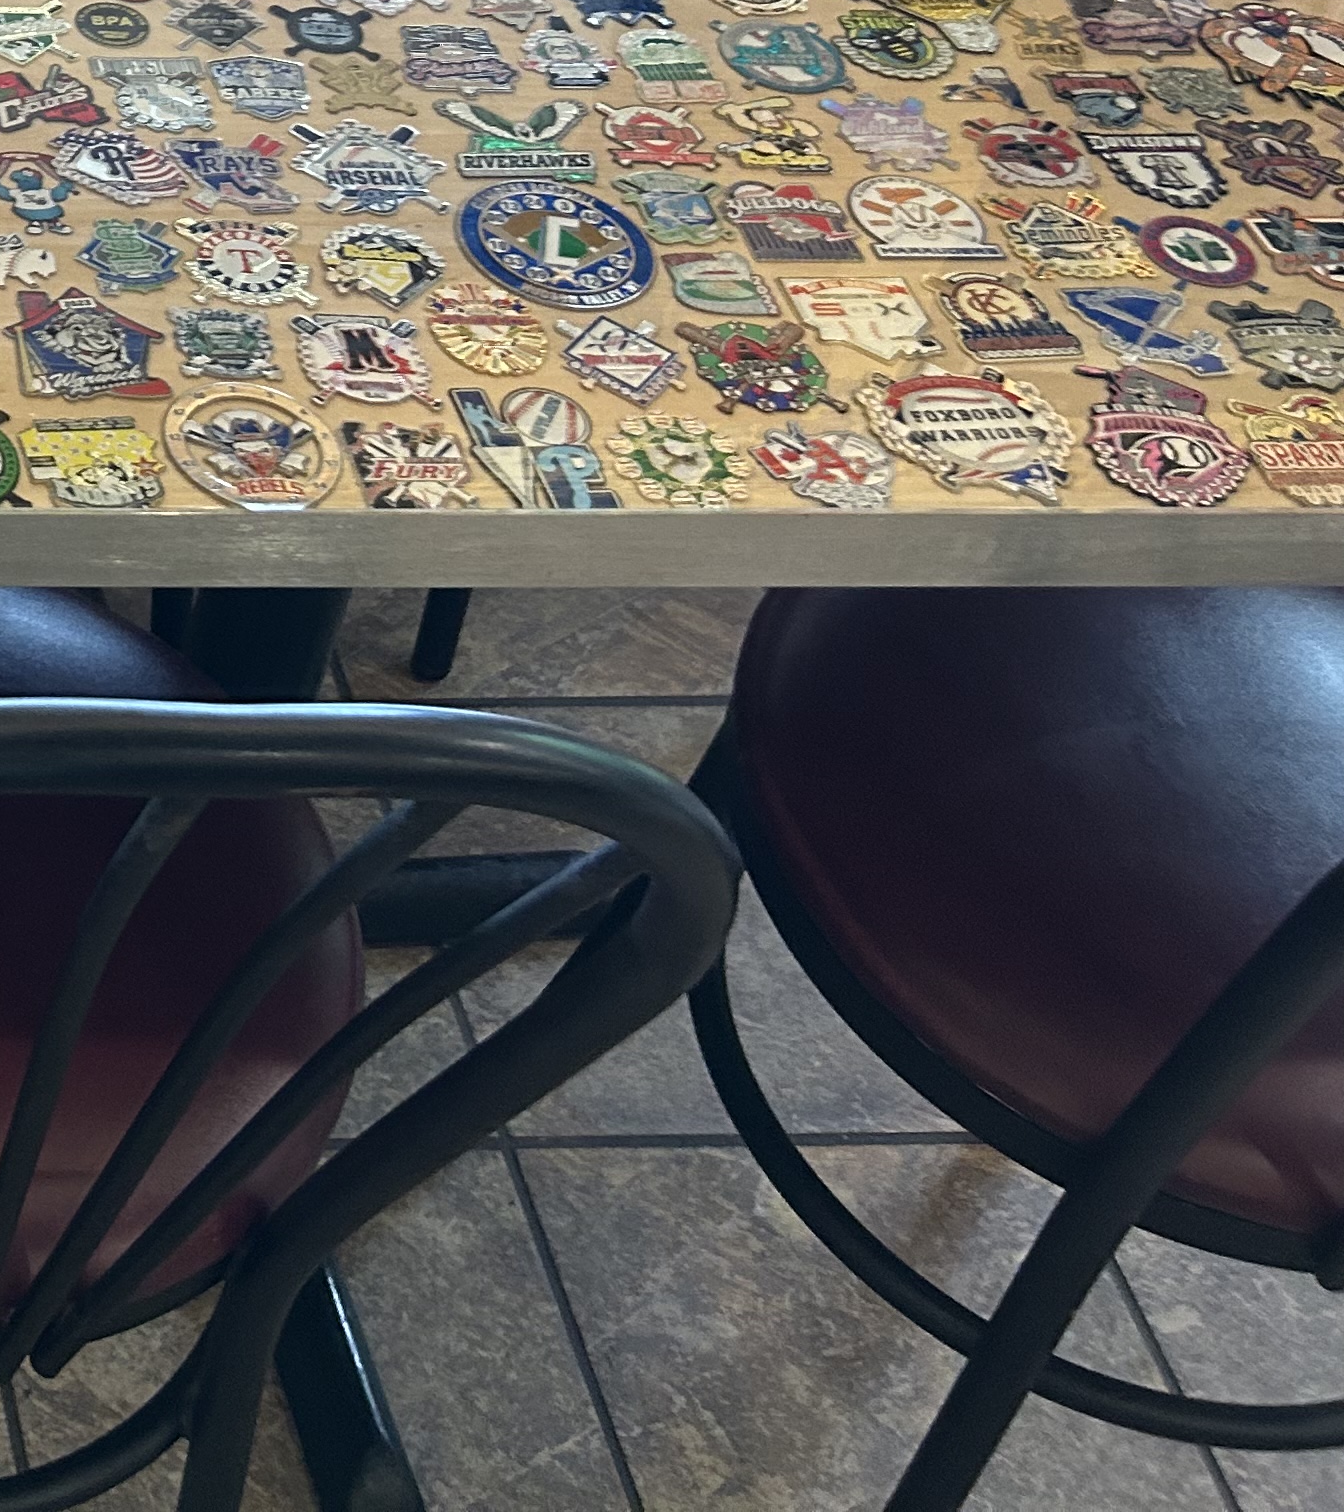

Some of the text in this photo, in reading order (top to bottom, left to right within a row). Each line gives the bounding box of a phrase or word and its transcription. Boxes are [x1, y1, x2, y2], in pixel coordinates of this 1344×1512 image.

[90, 16, 135, 27] BPA
[220, 88, 307, 102] SABERS
[200, 158, 278, 175] RAYS
[464, 155, 591, 170] RIVERHAWKS
[326, 170, 421, 186] ARSENAL
[1011, 222, 1124, 243] Seminoles
[228, 249, 262, 274] T
[343, 329, 386, 372] M
[912, 408, 1016, 424] FOXBORO
[912, 428, 1047, 442] WARRIORS
[372, 462, 458, 481] FURY
[237, 479, 304, 497] REBELS
